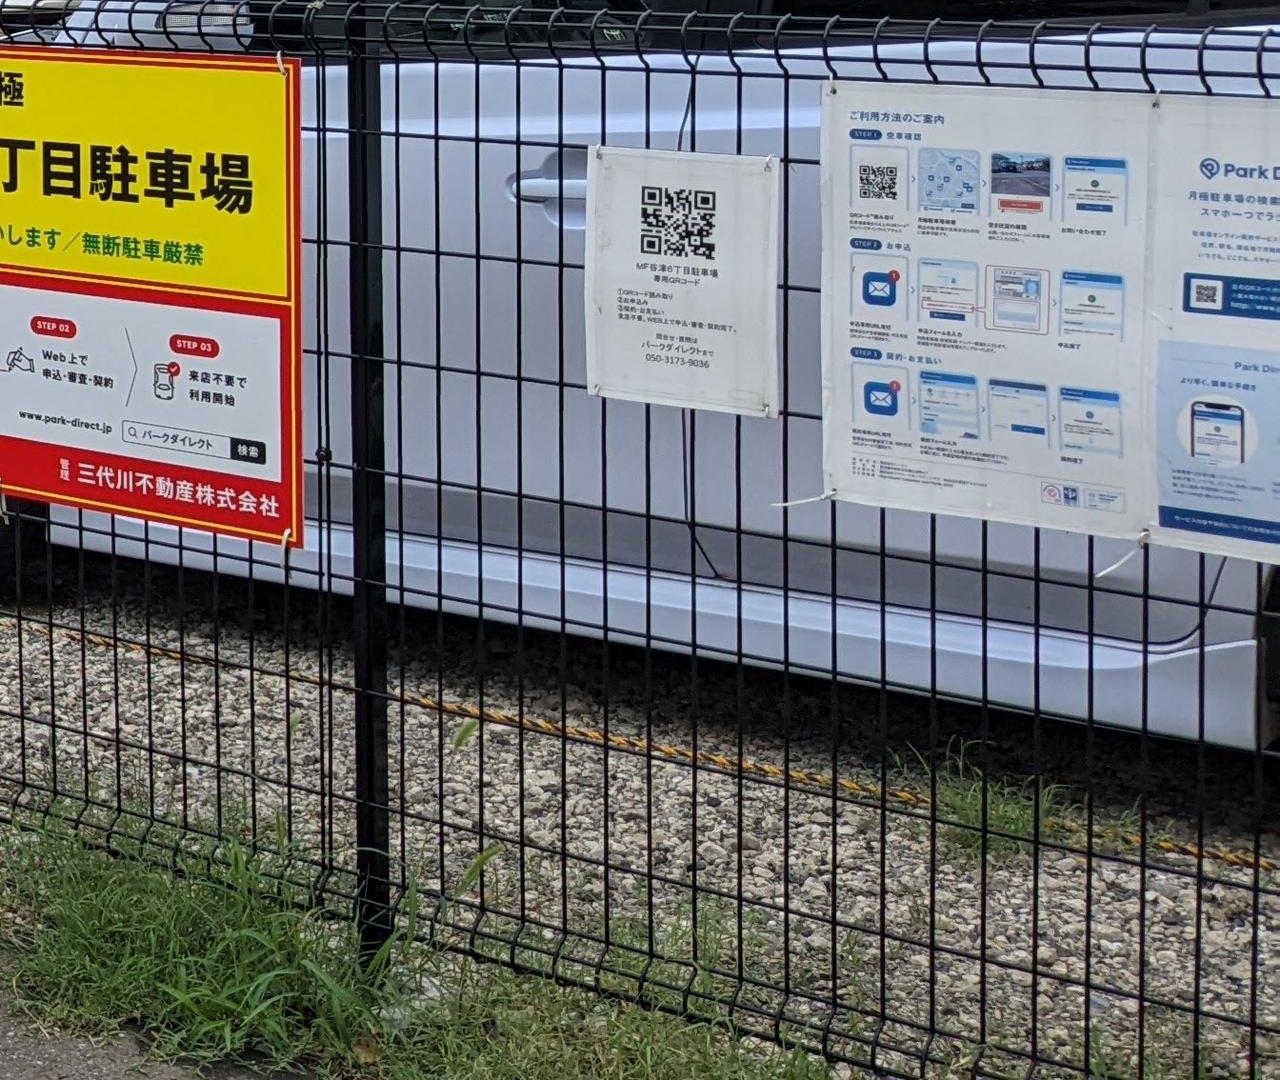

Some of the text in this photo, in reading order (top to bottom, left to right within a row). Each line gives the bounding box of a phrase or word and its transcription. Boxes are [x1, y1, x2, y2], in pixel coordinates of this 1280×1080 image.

[850, 110, 945, 125] ご利用方法のご案内
[886, 131, 922, 141] 空車確認
[1223, 162, 1270, 181] Park
[886, 241, 912, 252] お申込
[635, 261, 719, 278] MF谷津6丁目駐車場
[653, 274, 701, 287] 専用QRコード
[37, 320, 70, 333] STEP 02
[176, 339, 212, 353] STEP 03
[641, 339, 715, 357] パークダイレクトまで
[644, 352, 711, 369] 050-3173-9036
[886, 351, 943, 365] 契約・お支払い
[1234, 361, 1260, 373] Park
[188, 370, 247, 389] 来店不要で
[189, 389, 236, 407] 利用開始
[18, 410, 113, 435] www.park-direct.jp
[141, 429, 214, 451] パークダイレクト
[237, 443, 260, 458] 検索
[59, 458, 71, 481] 管理
[77, 462, 281, 518] 三代川不動産株式会社
